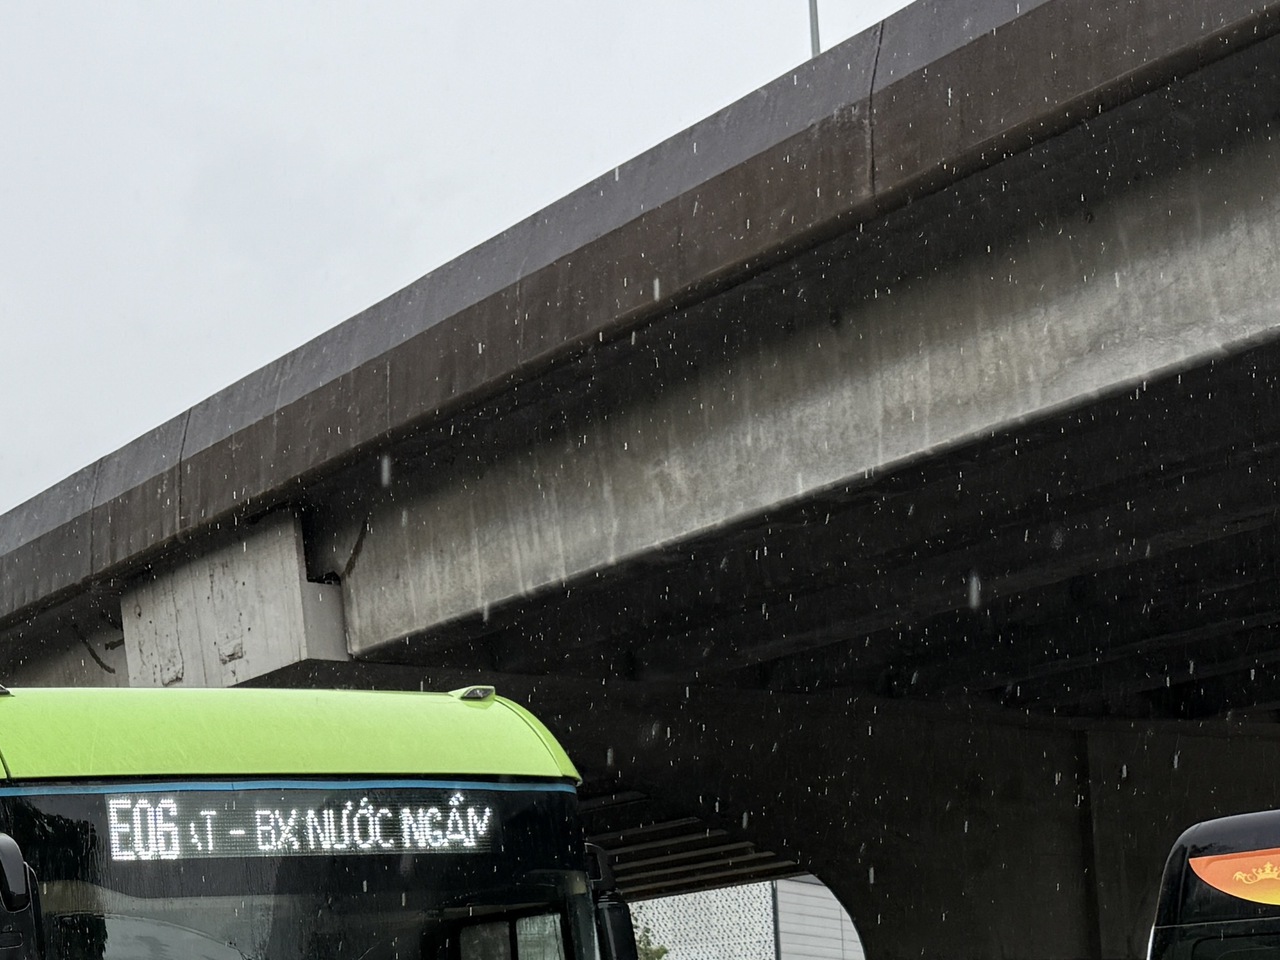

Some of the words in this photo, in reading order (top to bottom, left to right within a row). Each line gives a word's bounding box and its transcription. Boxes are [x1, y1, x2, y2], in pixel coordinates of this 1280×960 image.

[109, 799, 180, 860] E06
[255, 808, 300, 852] BX
[306, 797, 394, 849] NƯỚC
